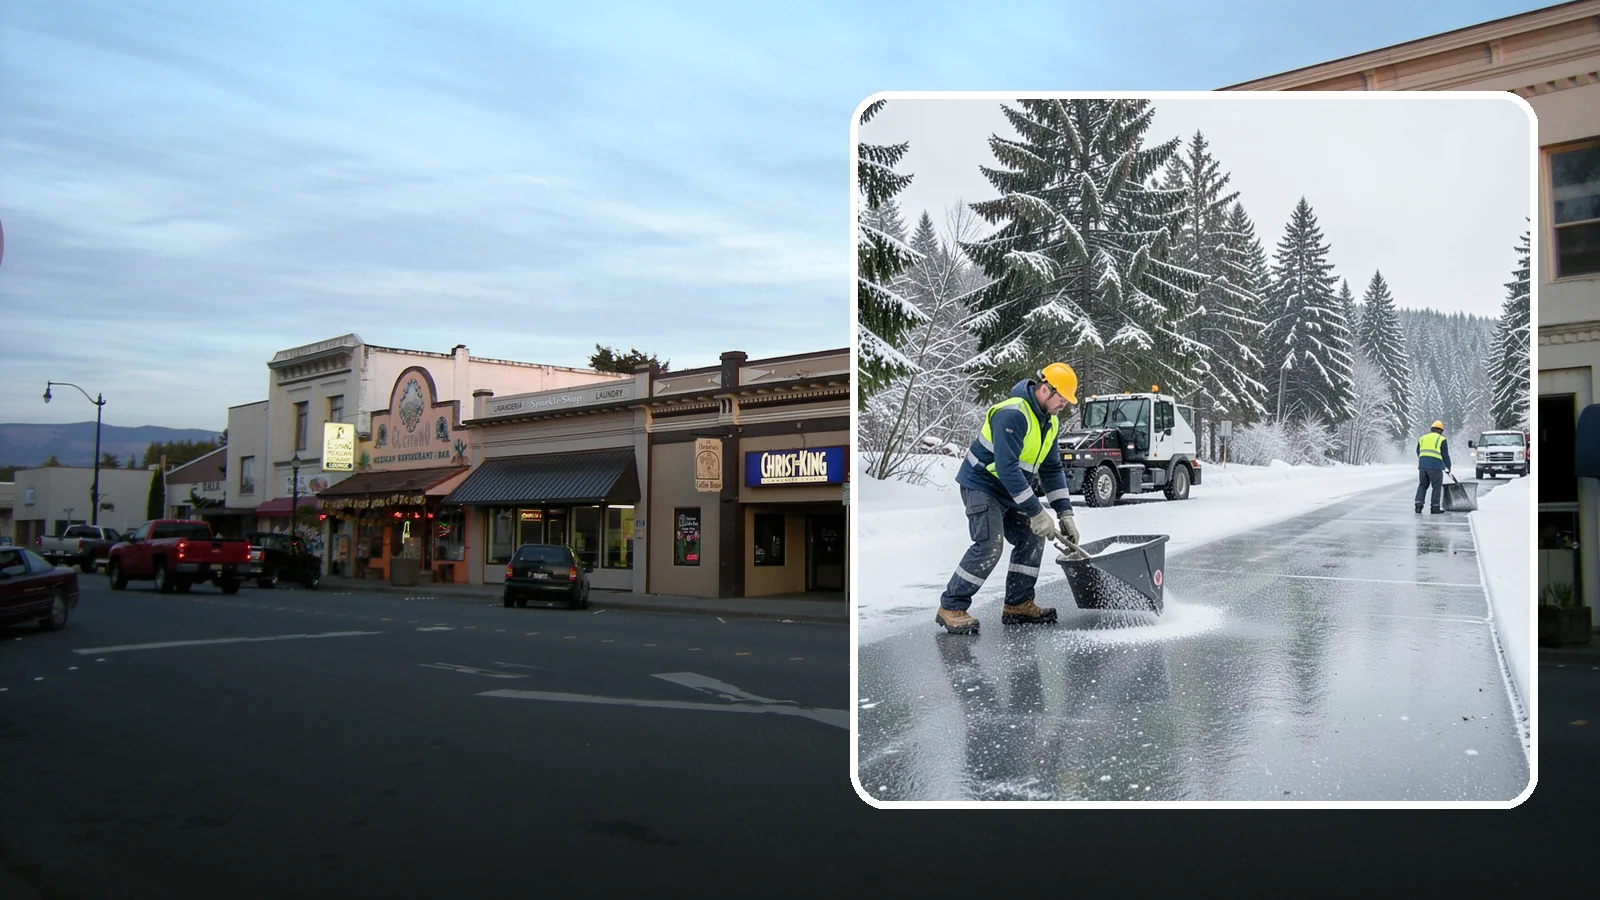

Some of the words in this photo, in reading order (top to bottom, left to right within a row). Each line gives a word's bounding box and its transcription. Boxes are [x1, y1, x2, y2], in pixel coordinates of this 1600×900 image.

[595, 389, 623, 400] LAUNDRY
[493, 402, 522, 412] LAVANDERIA
[530, 397, 561, 409] Sparkle
[561, 394, 582, 405] Shop
[373, 454, 396, 464] MEXICAN
[397, 451, 433, 462] RESTAURANT
[437, 450, 450, 459] BAR
[761, 452, 797, 478] CHRIST
[799, 450, 827, 476] KING
[709, 481, 722, 489] House
